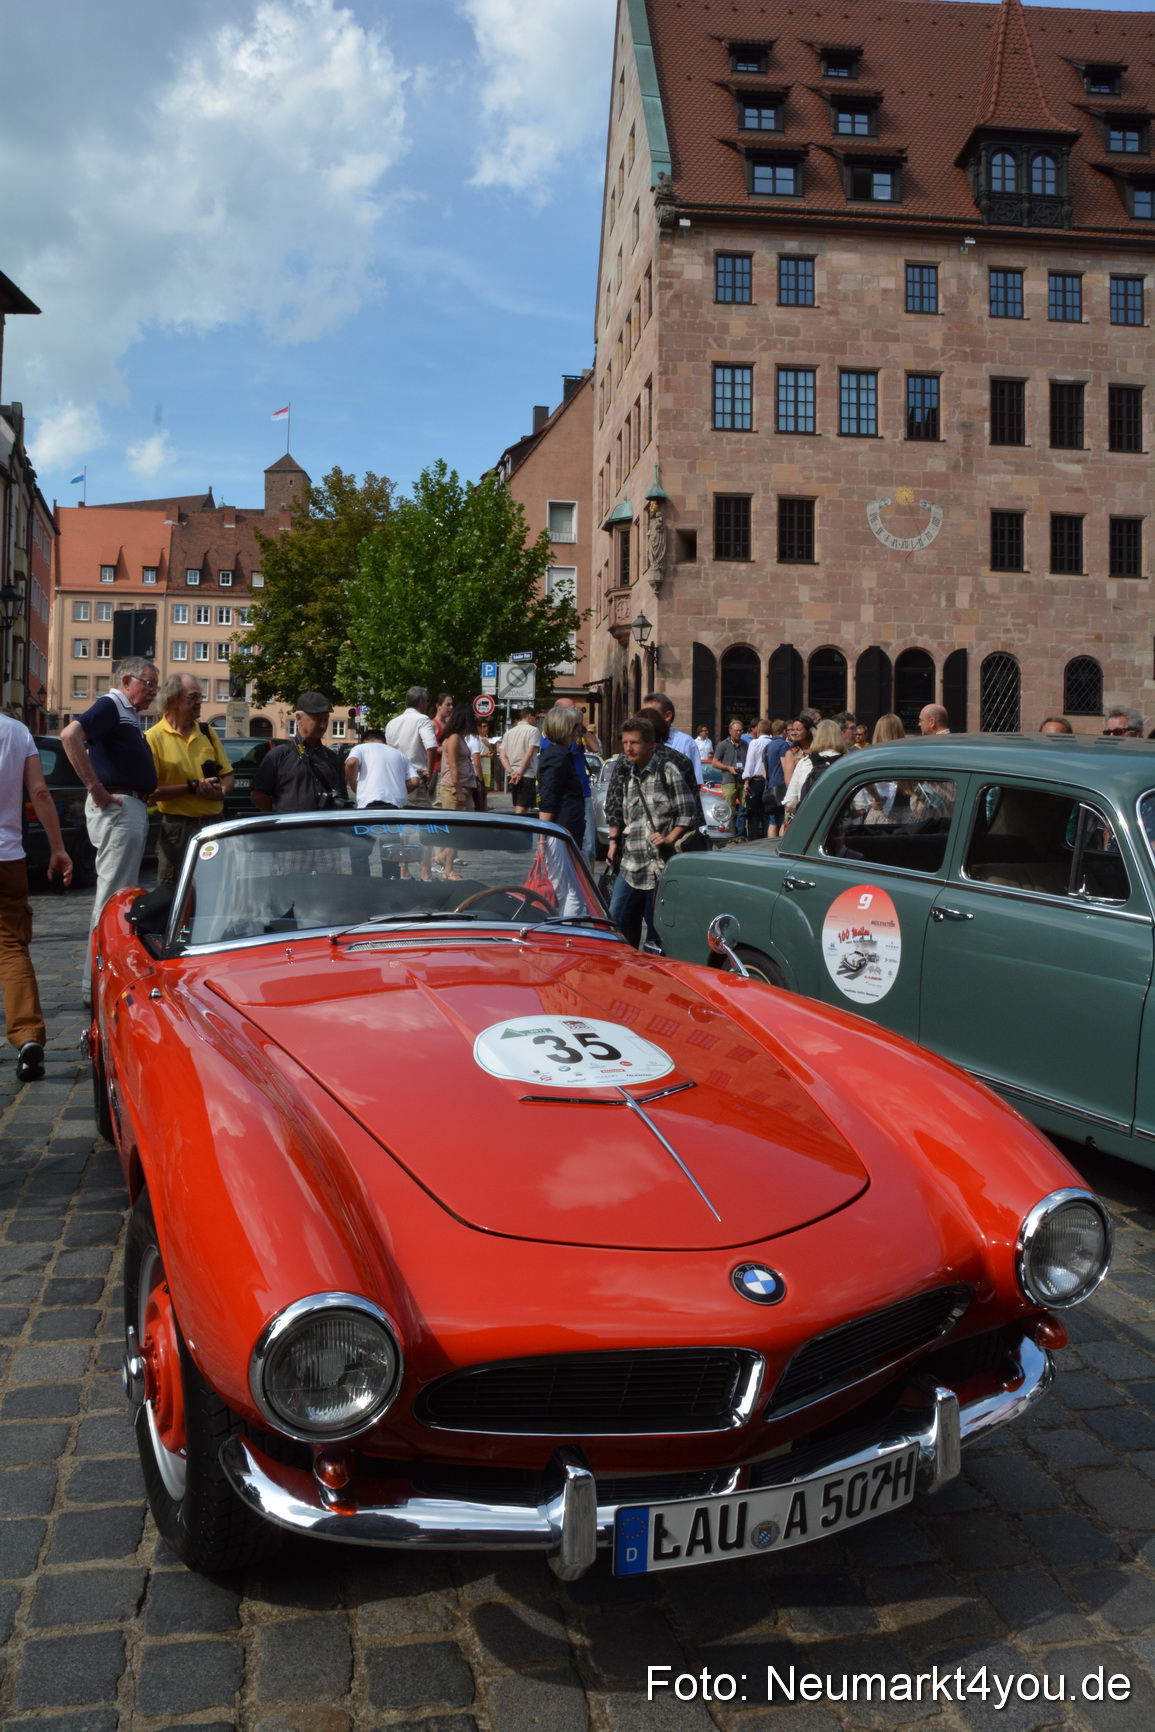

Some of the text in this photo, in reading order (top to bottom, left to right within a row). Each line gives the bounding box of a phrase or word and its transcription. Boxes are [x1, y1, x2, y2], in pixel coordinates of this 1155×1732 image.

[486, 664, 493, 676] P
[858, 894, 873, 909] 9
[838, 926, 870, 943] 100 Meilen
[532, 1032, 622, 1064] 35
[735, 1265, 774, 1279] BMW
[653, 1452, 914, 1560] LAU A 507H
[626, 1548, 637, 1562] D
